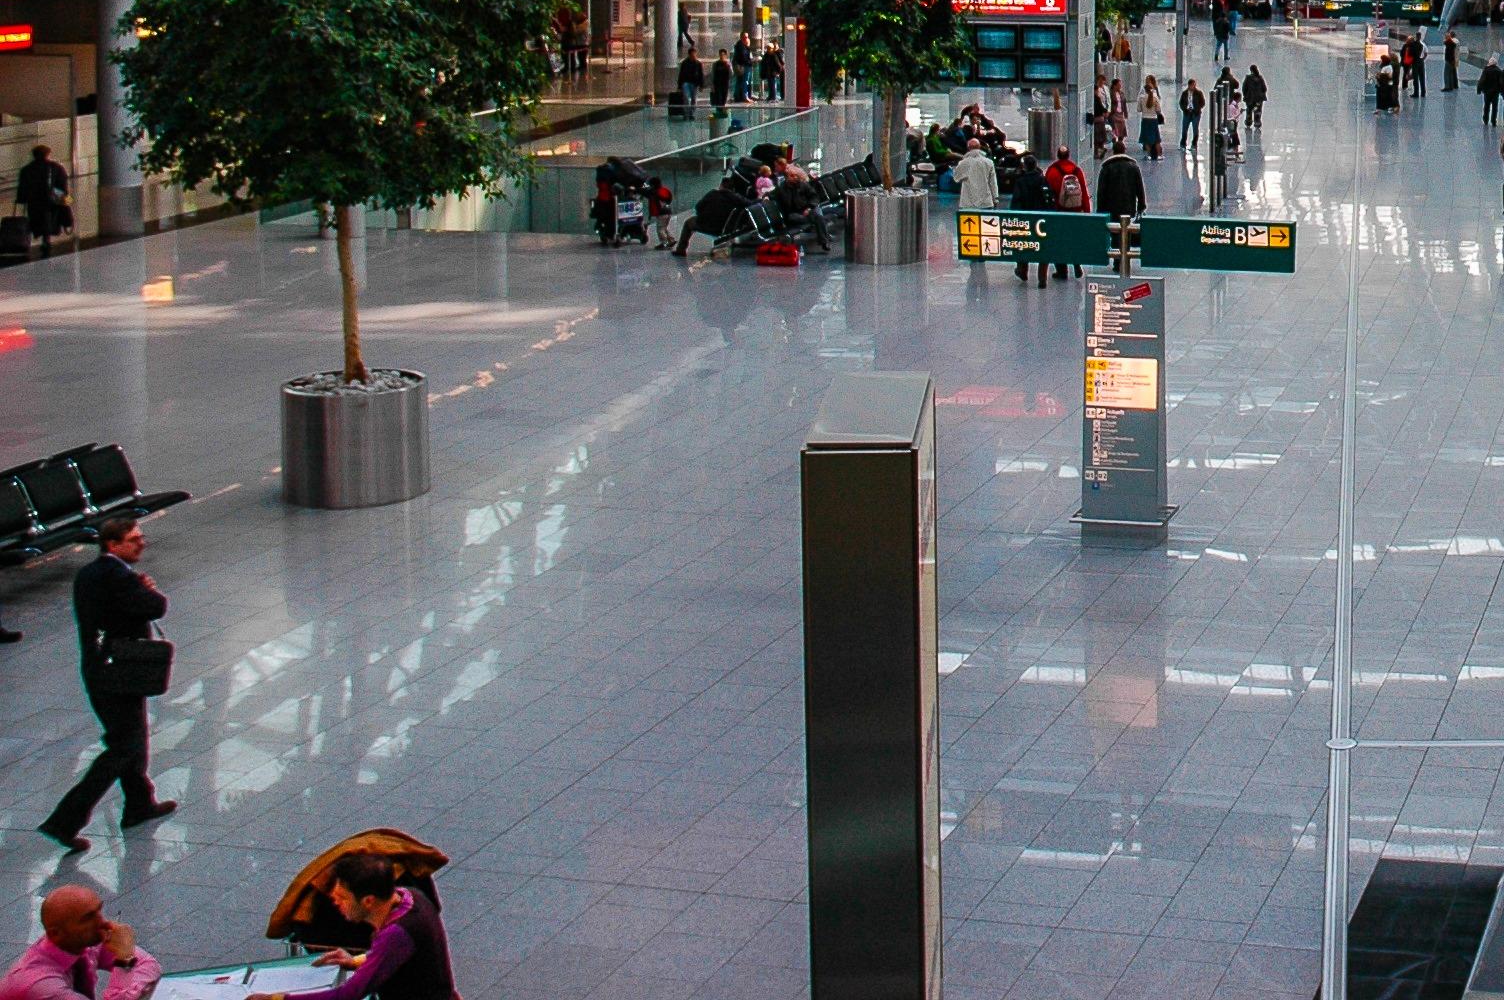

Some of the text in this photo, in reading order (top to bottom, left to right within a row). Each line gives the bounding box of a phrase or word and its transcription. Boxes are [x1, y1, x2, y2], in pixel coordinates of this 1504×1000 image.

[1001, 218, 1047, 237] Abflug C
[1201, 225, 1247, 245] Abflug B
[1001, 238, 1040, 252] Ausgang
